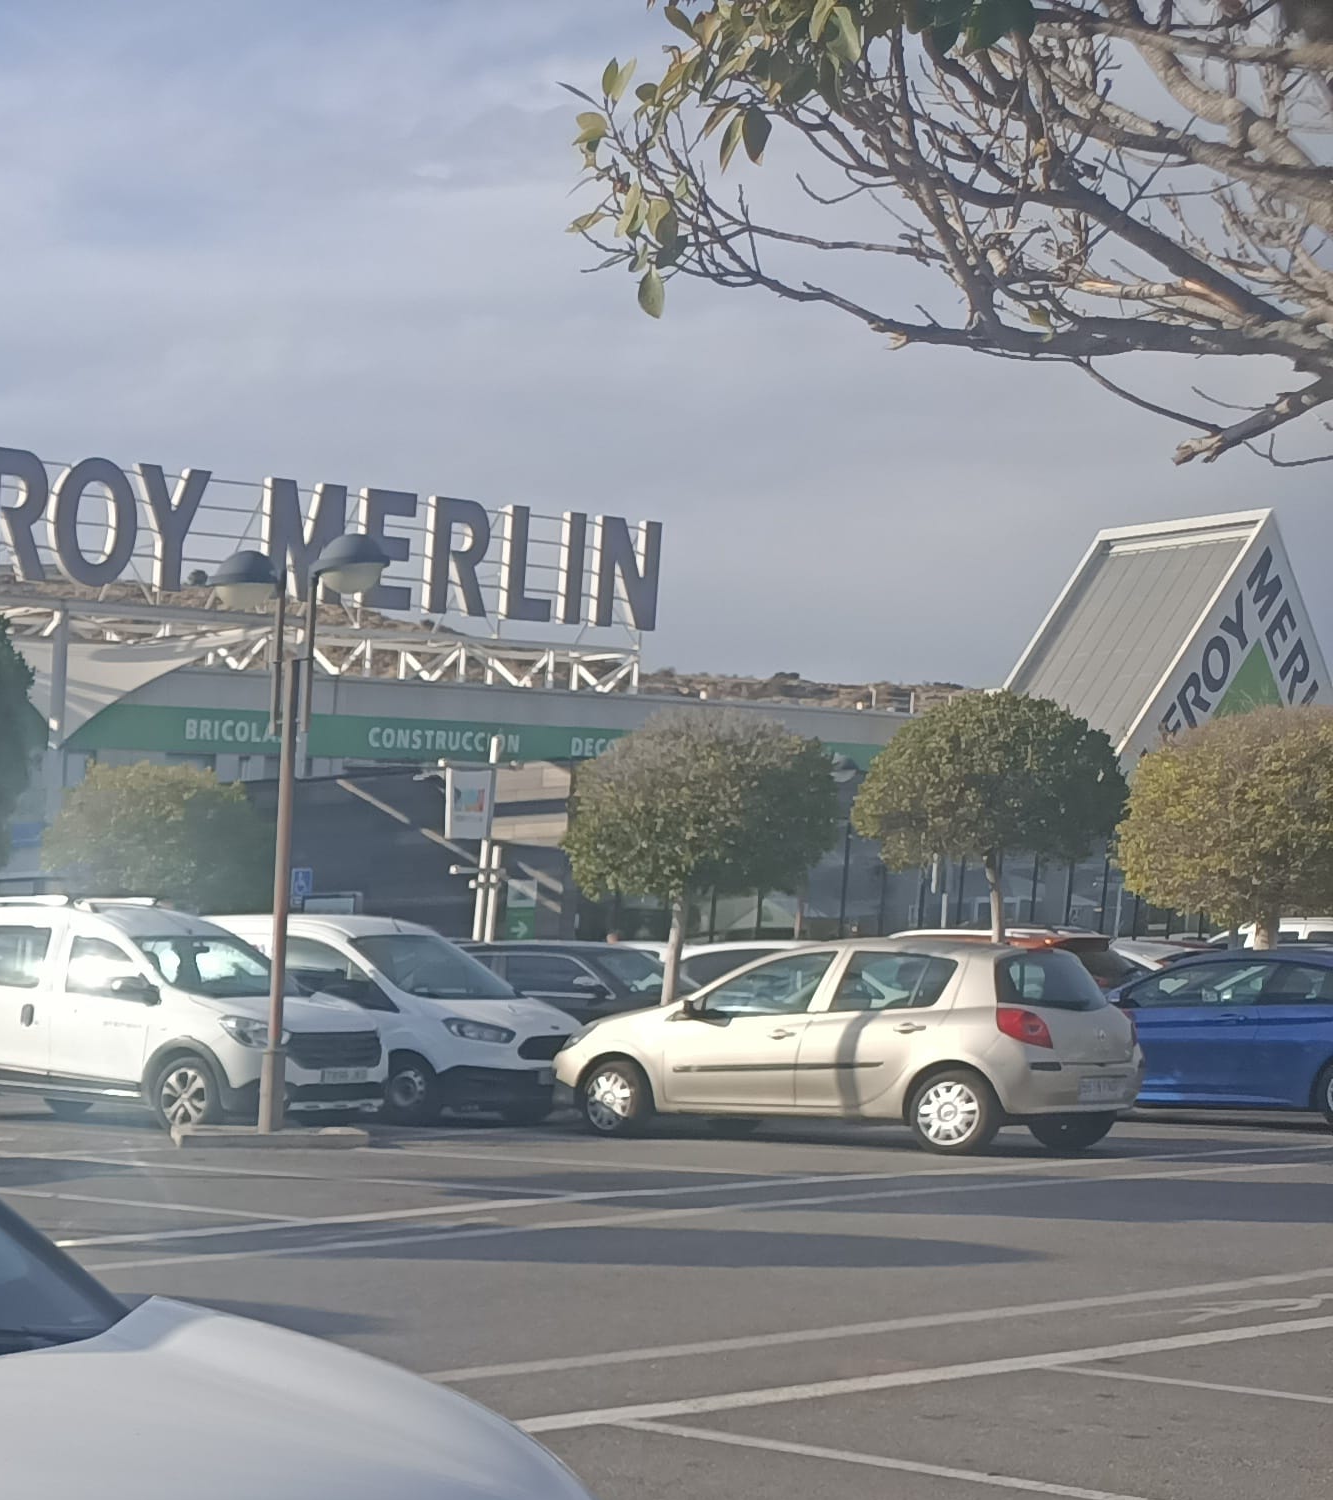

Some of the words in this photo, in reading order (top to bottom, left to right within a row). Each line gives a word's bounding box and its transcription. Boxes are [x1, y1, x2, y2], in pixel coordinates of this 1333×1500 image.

[262, 476, 664, 632] MERLIN
[1140, 589, 1248, 757] EROY
[1246, 546, 1319, 706] MER
